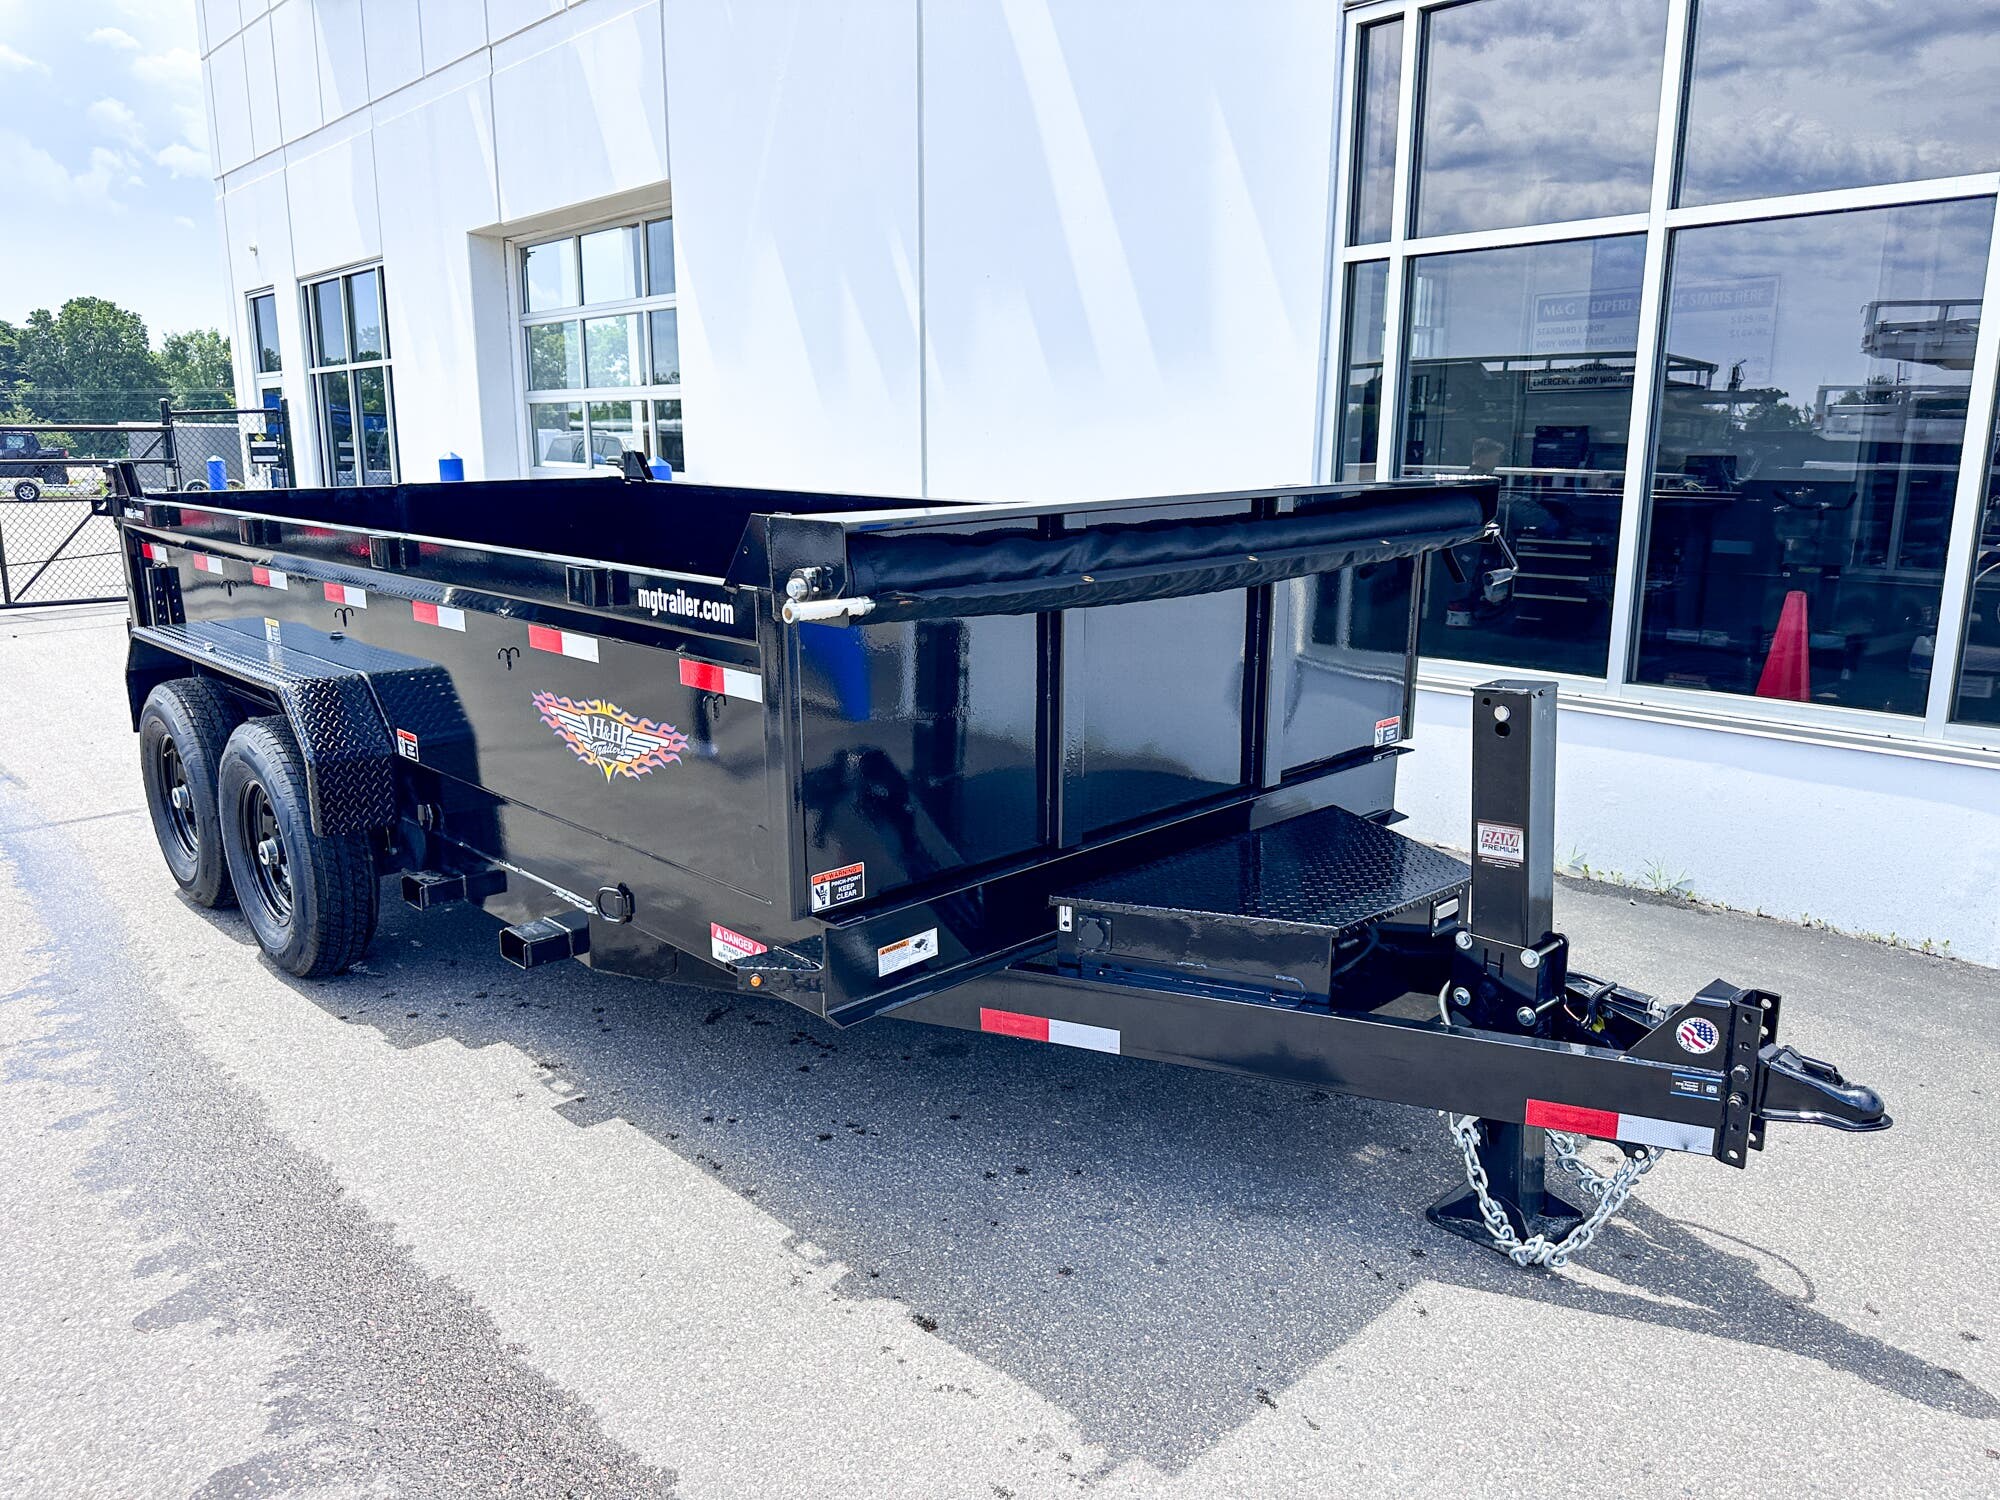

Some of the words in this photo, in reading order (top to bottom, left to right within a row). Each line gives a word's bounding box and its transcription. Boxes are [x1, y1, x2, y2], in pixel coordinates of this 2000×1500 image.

[1543, 302, 1576, 317] M&G
[1591, 298, 1632, 314] EXPERT
[1532, 377, 1576, 387] EMERGENCY
[637, 587, 735, 625] mgtrailer.com
[592, 715, 624, 746] H&H
[590, 741, 627, 758] Trailers
[1481, 830, 1520, 848] RAM
[1482, 843, 1520, 854] PREMIUM
[829, 867, 857, 879] WARNING
[831, 873, 862, 888] PINCH-POINT
[836, 889, 857, 900] CLEAR
[838, 883, 855, 893] KEEP
[723, 930, 754, 954] DANGER
[885, 941, 907, 953] WARNING
